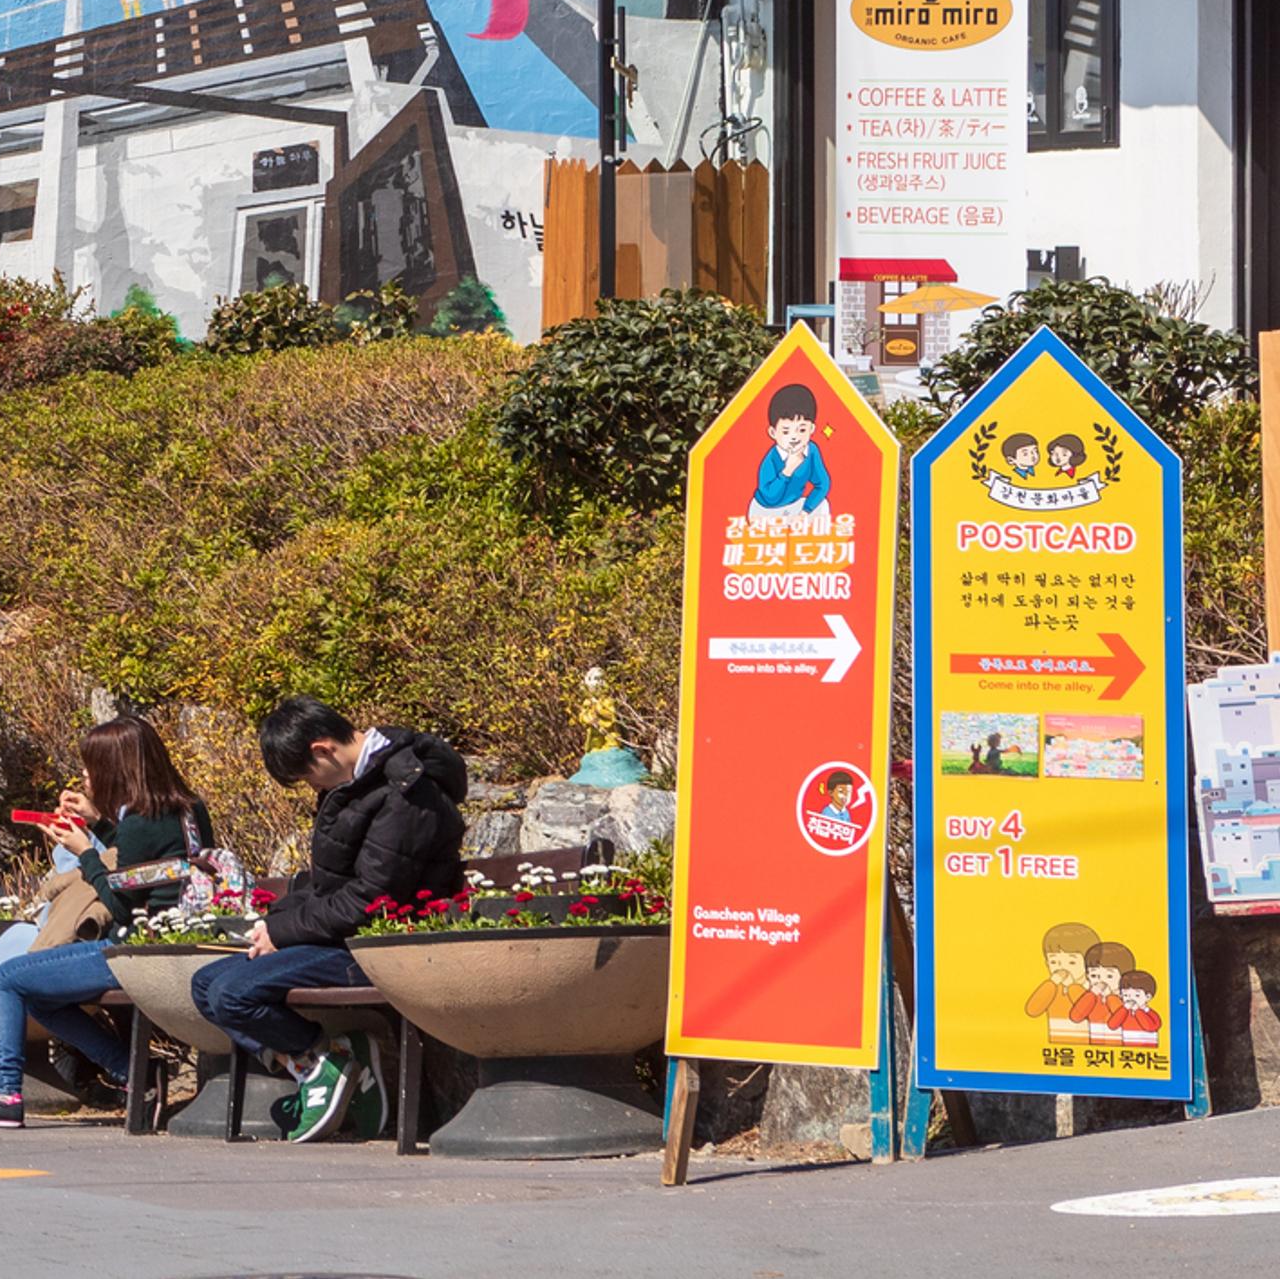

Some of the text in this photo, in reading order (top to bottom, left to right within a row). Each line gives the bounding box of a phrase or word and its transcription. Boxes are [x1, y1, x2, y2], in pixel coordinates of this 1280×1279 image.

[875, 1, 998, 25] miro miro
[895, 32, 967, 46] ORGANIC CAFE
[858, 87, 1007, 107] COFFEE & LATTE
[858, 152, 1007, 170] FRESH FRUIT JUICE
[857, 173, 946, 192] (생과일주스)
[857, 206, 1003, 226] BEVERAGE (음료)
[1000, 486, 1091, 505] 감천문화마을
[726, 514, 856, 538] 감천문화마을
[959, 522, 1134, 552] POSTCARD
[723, 541, 855, 566] 마그넷 도자기
[725, 574, 851, 599] SOUVENIR
[1035, 573, 1081, 588] 필요는
[960, 594, 1136, 610] 정서에 도움이 되는 것을
[727, 663, 818, 676] Come into the alley.
[979, 679, 1095, 694] Come into the alley.
[948, 811, 1024, 840] BUY 4
[947, 847, 1076, 876] GET 1 FREE
[693, 905, 800, 926] Gamcheon Village
[692, 924, 800, 945] Ceramic Magnet
[1042, 1047, 1075, 1066] 말을
[1120, 1050, 1169, 1070] 못하는
[306, 1085, 328, 1107] N
